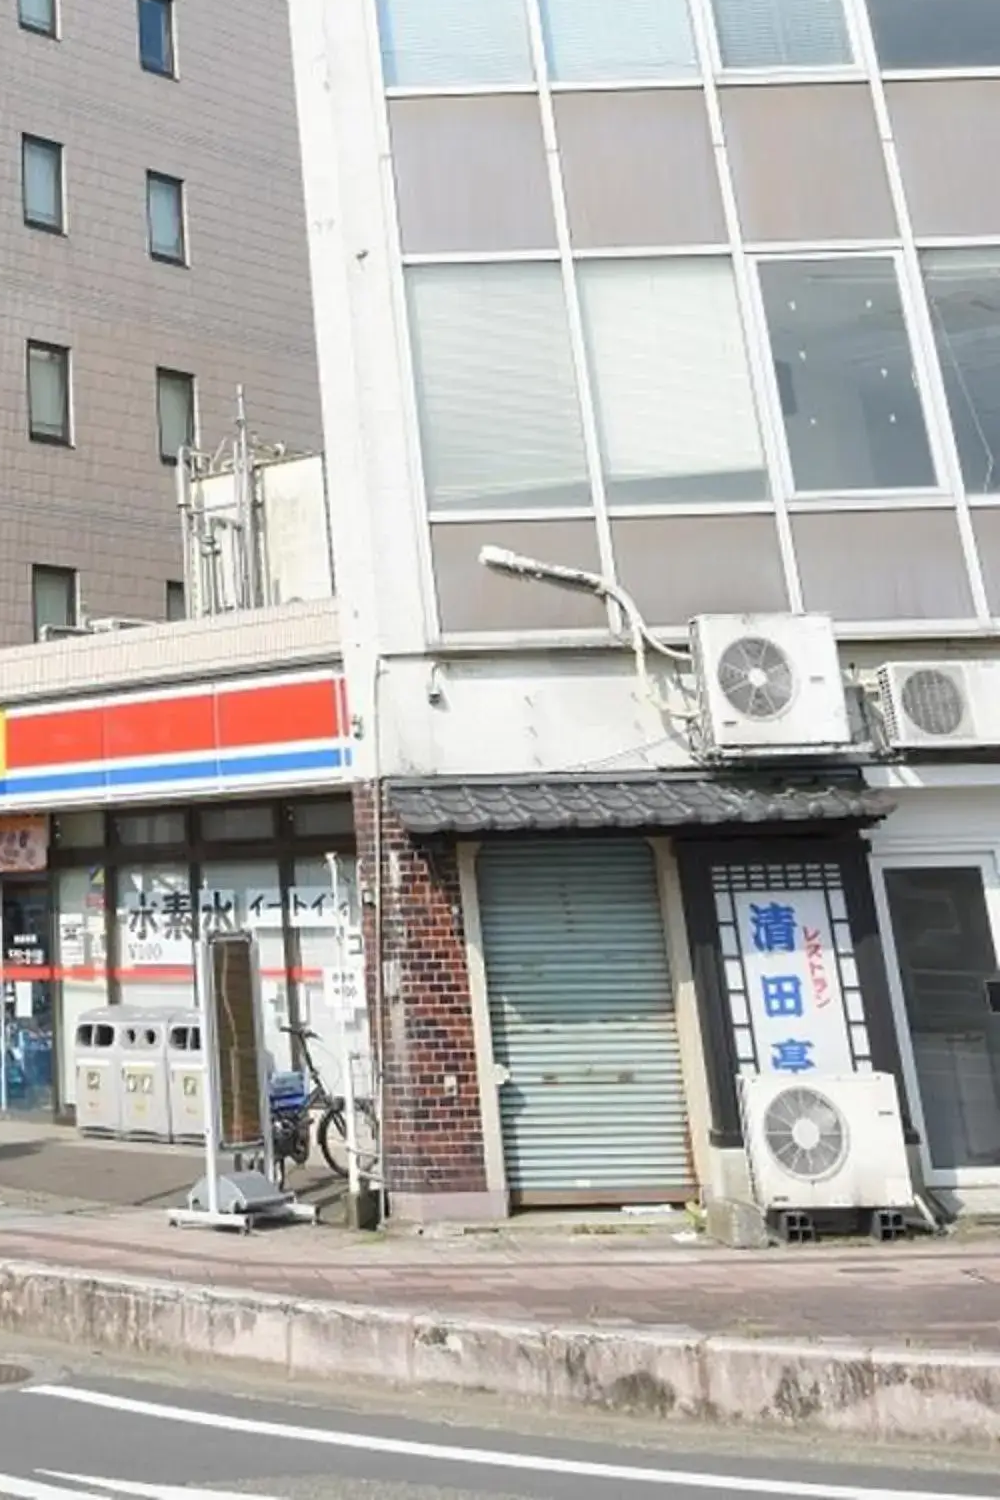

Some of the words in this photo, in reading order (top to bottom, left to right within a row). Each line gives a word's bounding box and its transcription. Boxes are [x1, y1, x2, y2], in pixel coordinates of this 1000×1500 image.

[128, 890, 234, 941] 水素水
[749, 901, 816, 1075] 清田亭
[803, 925, 832, 1009] レストラン
